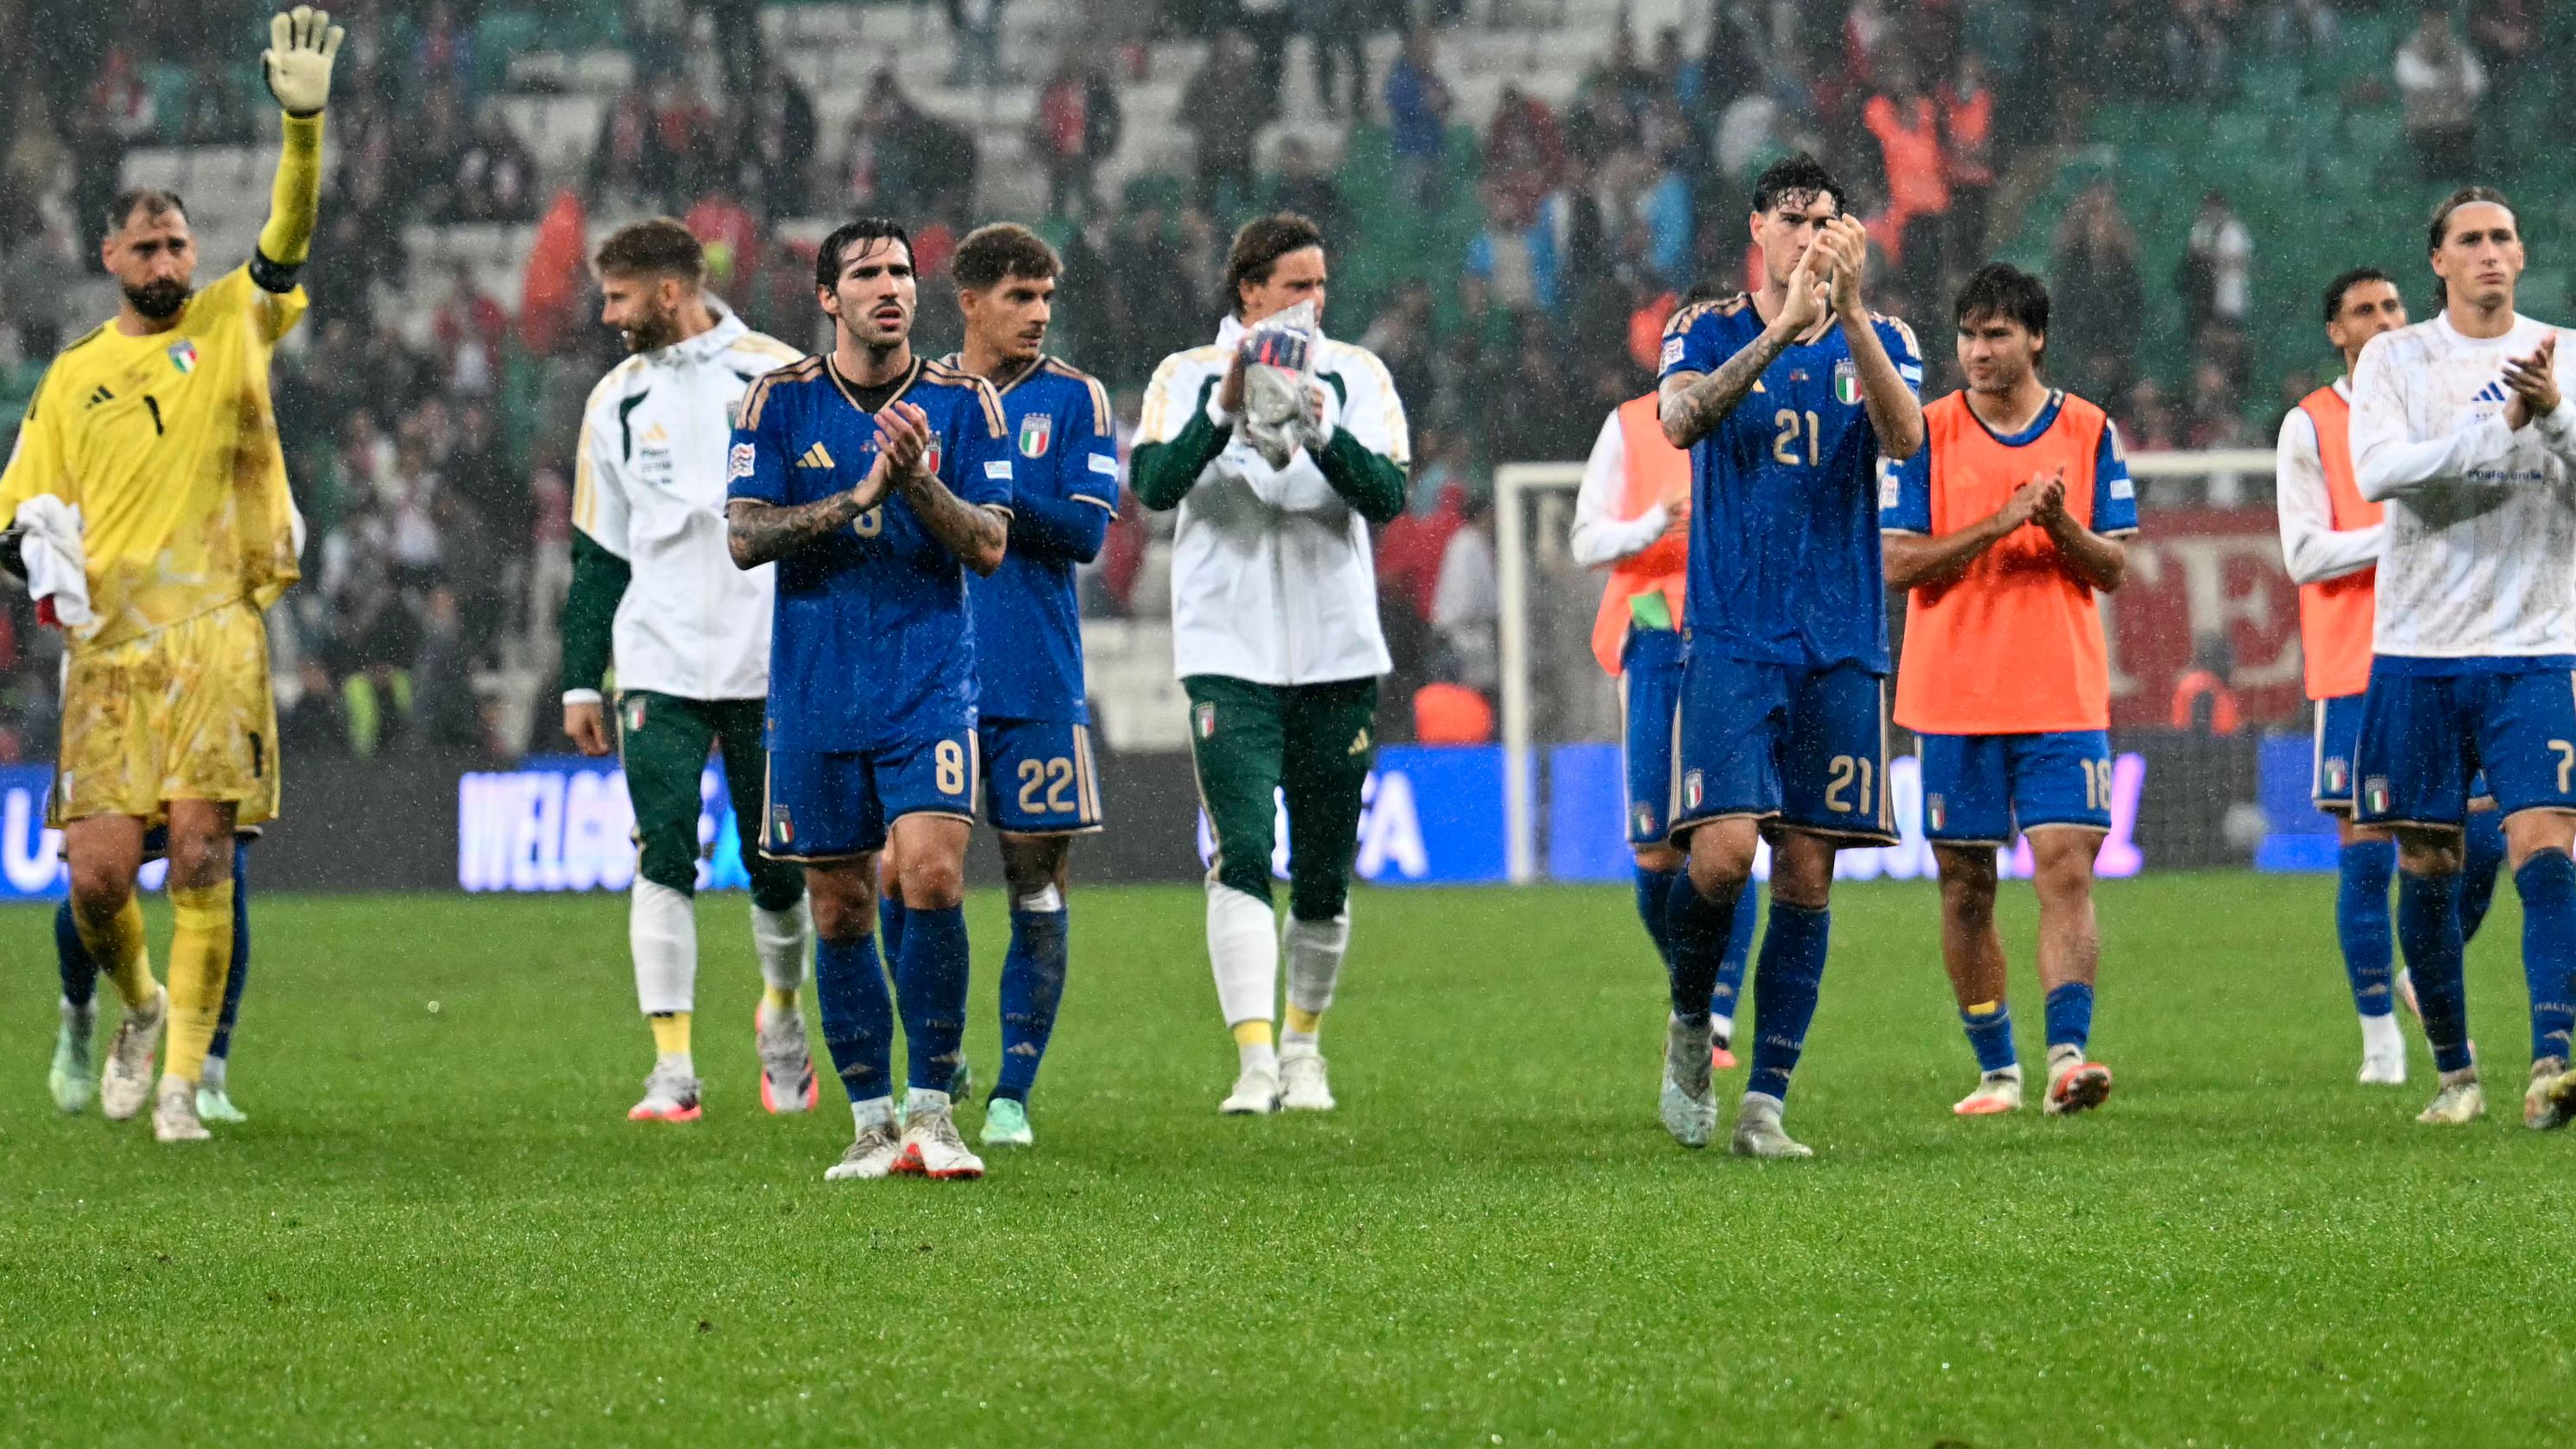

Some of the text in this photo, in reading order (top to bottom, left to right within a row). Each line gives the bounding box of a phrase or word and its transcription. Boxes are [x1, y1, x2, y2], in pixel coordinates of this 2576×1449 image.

[144, 396, 164, 436] 1
[1773, 409, 1820, 467] 21
[248, 731, 261, 777] 1
[934, 739, 964, 795] 8
[2548, 739, 2575, 794] 7
[1017, 756, 1076, 813] 22
[1825, 755, 1871, 814] 21
[2080, 758, 2112, 809] 18
